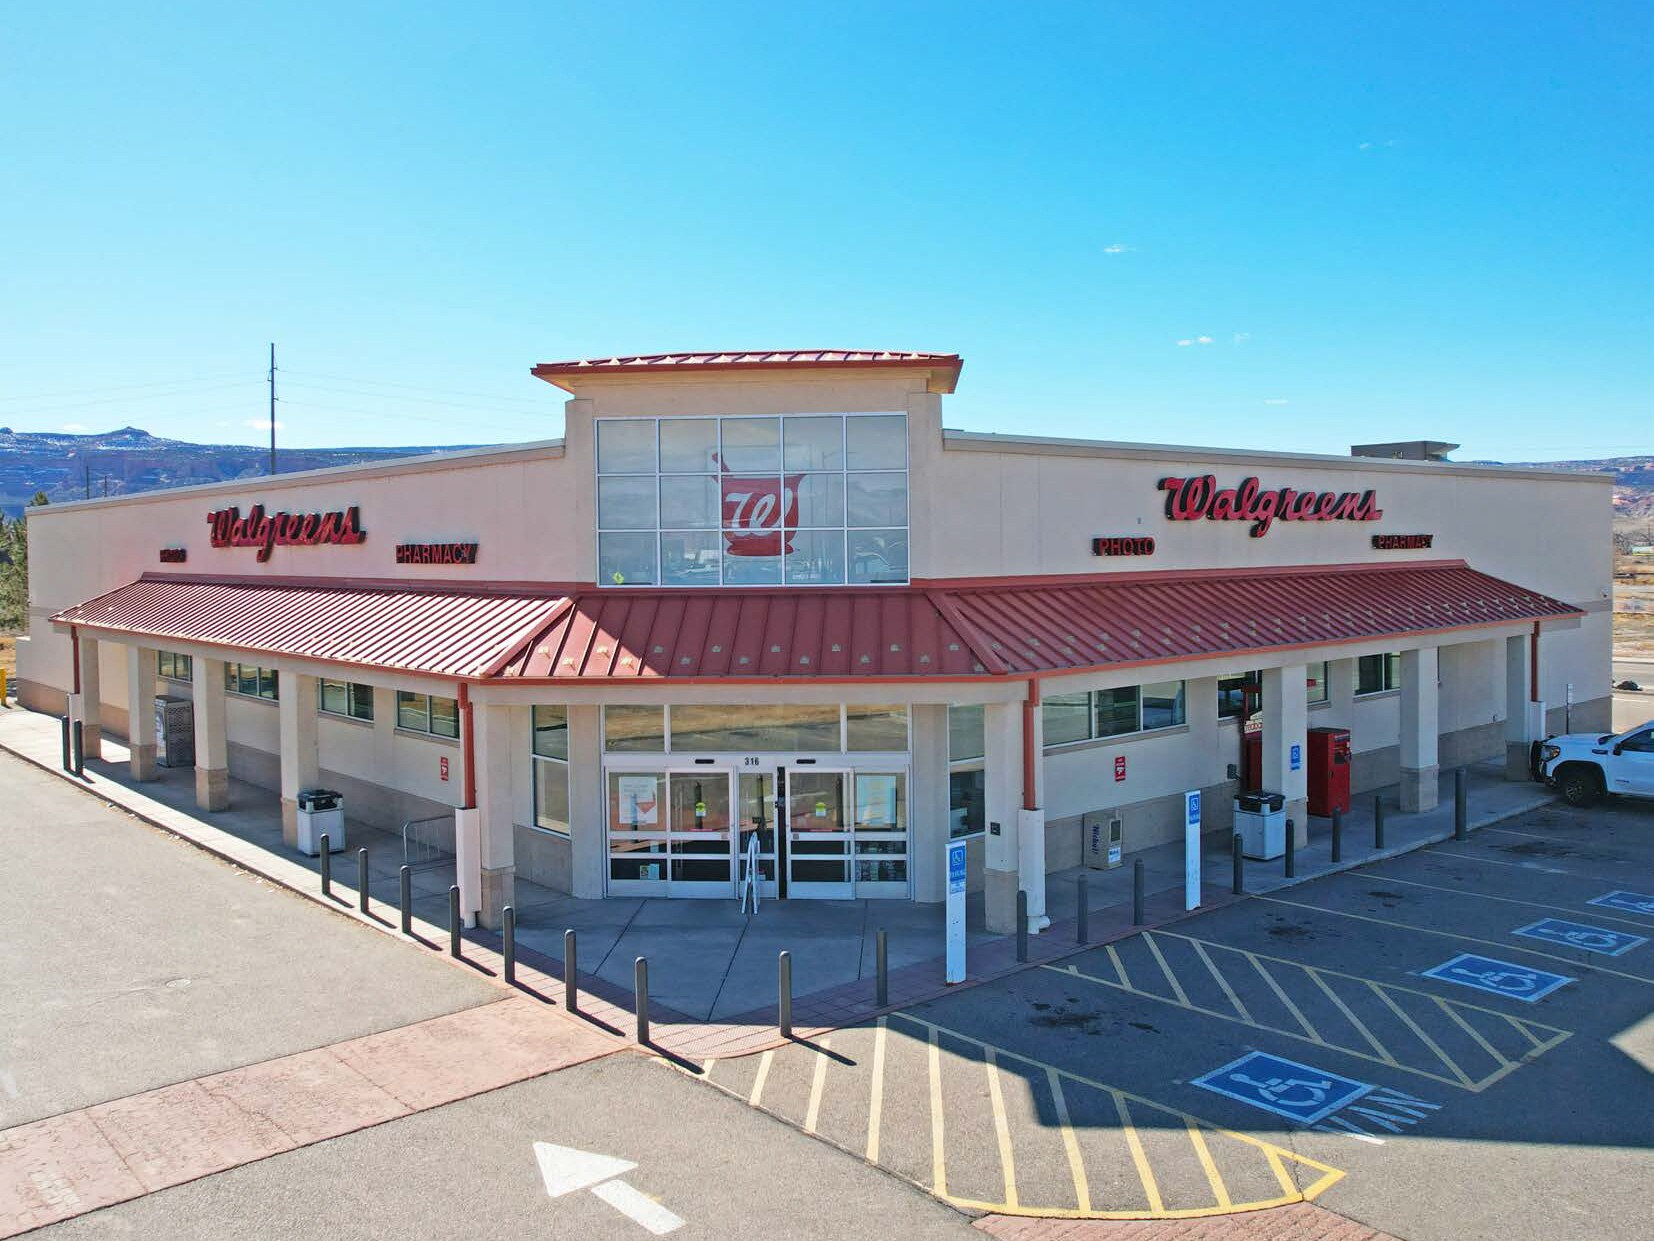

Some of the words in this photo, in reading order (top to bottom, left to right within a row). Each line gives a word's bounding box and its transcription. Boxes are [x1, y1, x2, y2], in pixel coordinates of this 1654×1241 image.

[1158, 475, 1383, 537] Walgreens
[207, 503, 367, 563] Walgreens
[1373, 534, 1433, 549] PHARMACY
[396, 543, 478, 564] PHARMACY
[1094, 537, 1155, 556] PHOTO
[744, 757, 760, 766] 316
